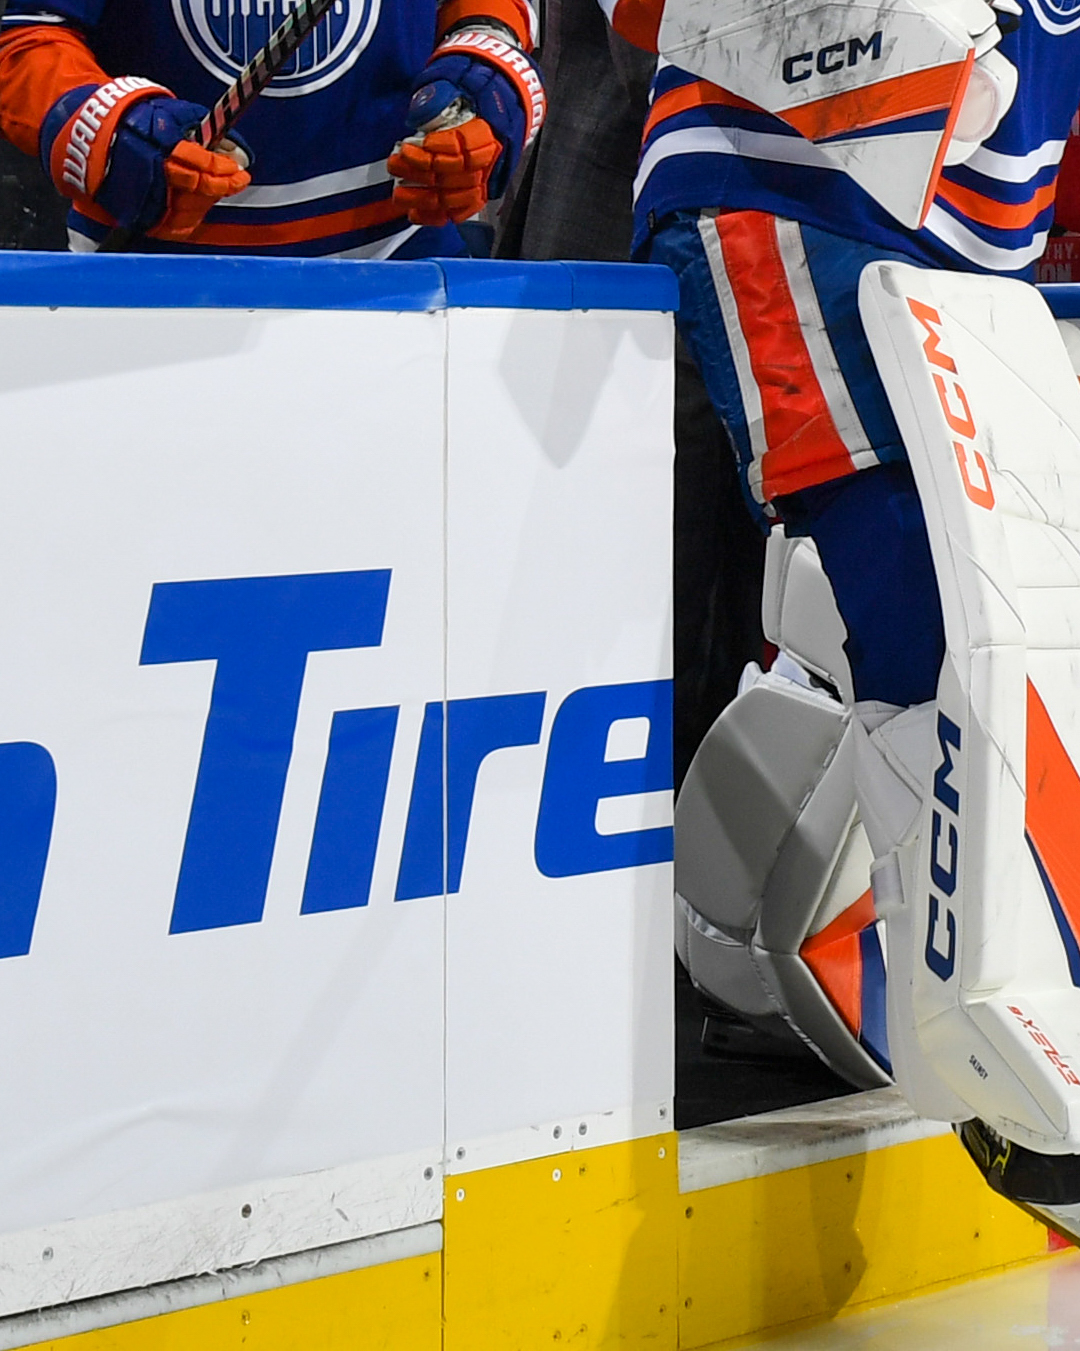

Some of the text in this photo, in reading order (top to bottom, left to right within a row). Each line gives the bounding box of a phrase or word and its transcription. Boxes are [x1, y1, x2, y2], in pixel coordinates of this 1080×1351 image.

[782, 30, 883, 85] CCM
[905, 295, 996, 512] CCM
[138, 568, 674, 936] Tire
[924, 708, 962, 983] CCM
